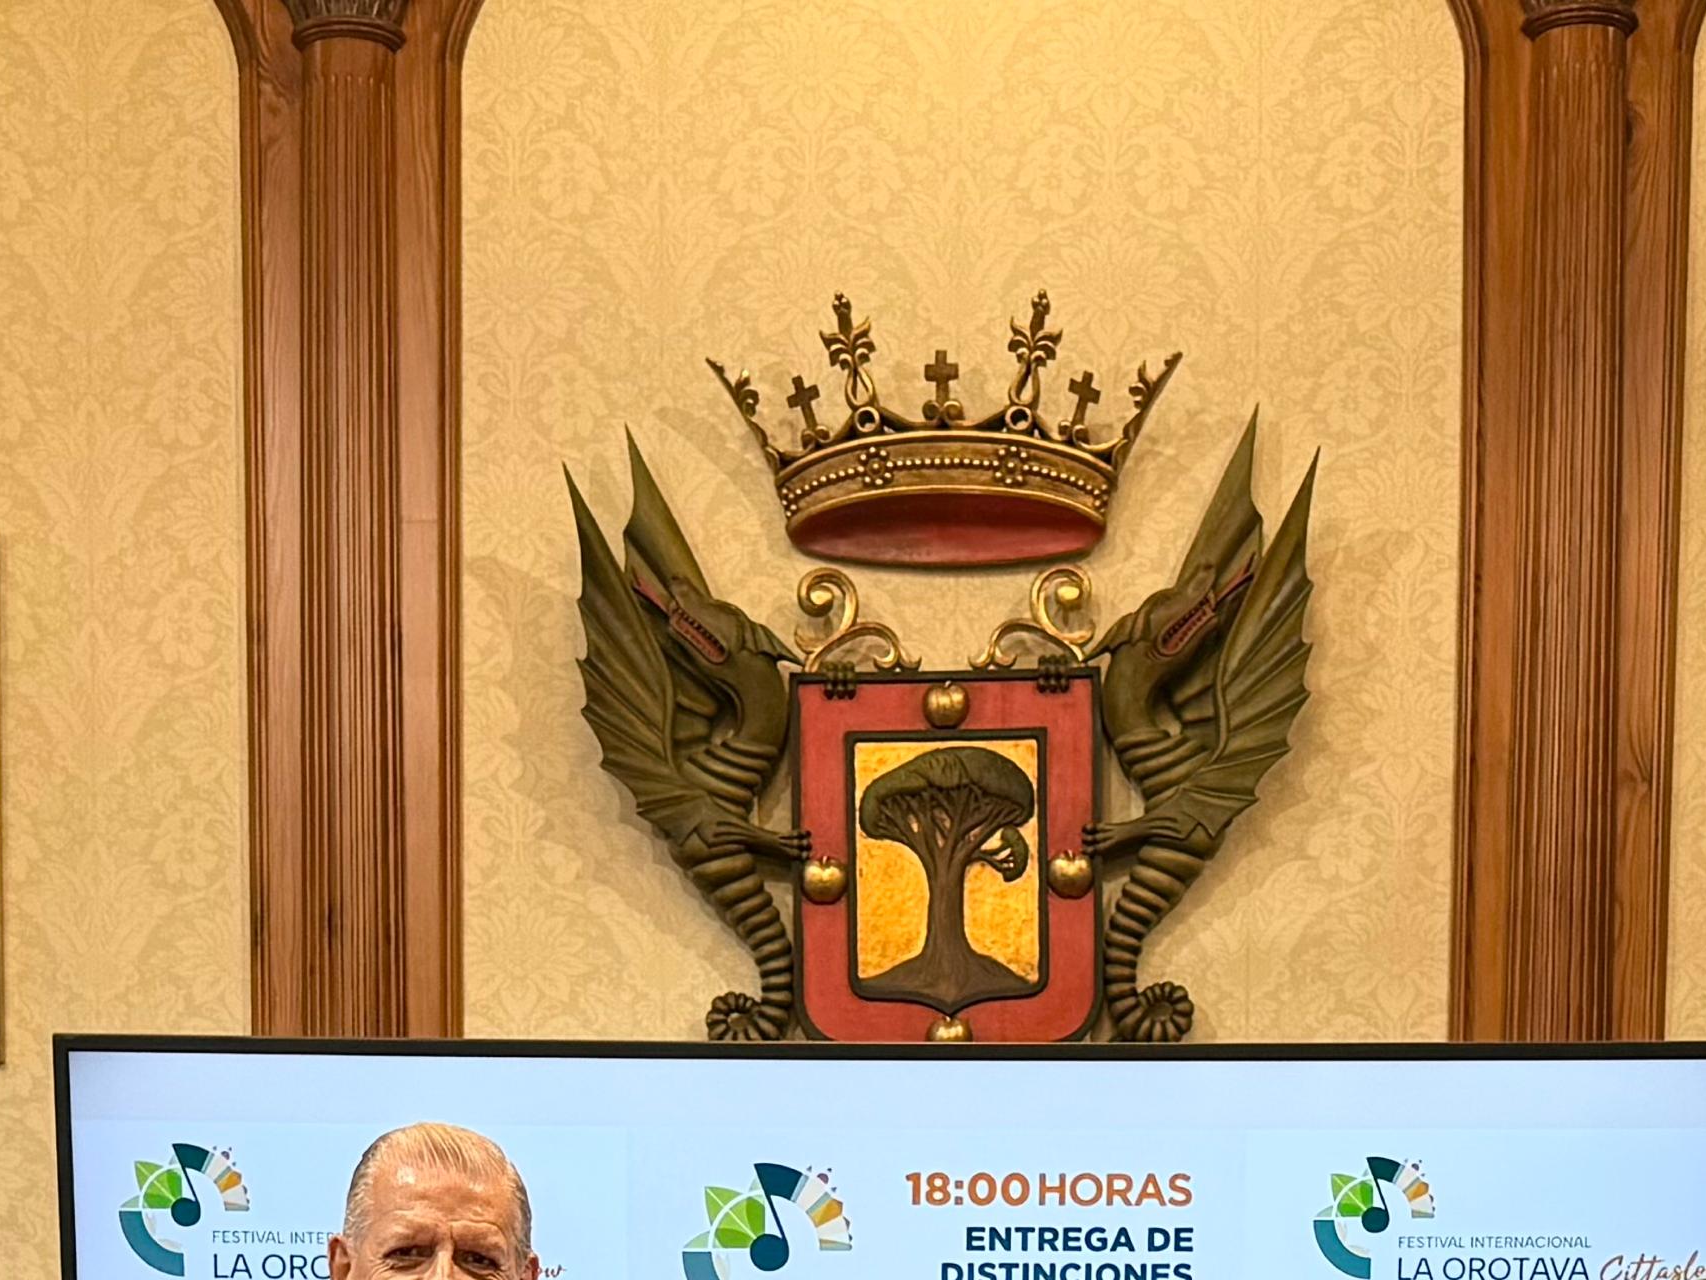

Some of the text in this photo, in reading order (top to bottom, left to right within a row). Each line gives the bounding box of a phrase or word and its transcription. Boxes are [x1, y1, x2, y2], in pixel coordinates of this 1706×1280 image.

[905, 1171, 1193, 1207] 18:00 HORAS
[212, 1230, 285, 1245] FESTIVAL
[965, 1226, 1194, 1253] ENTREGA DE
[1398, 1235, 1592, 1249] FESTIVAL INTERNACIONAL
[213, 1253, 253, 1280] LA
